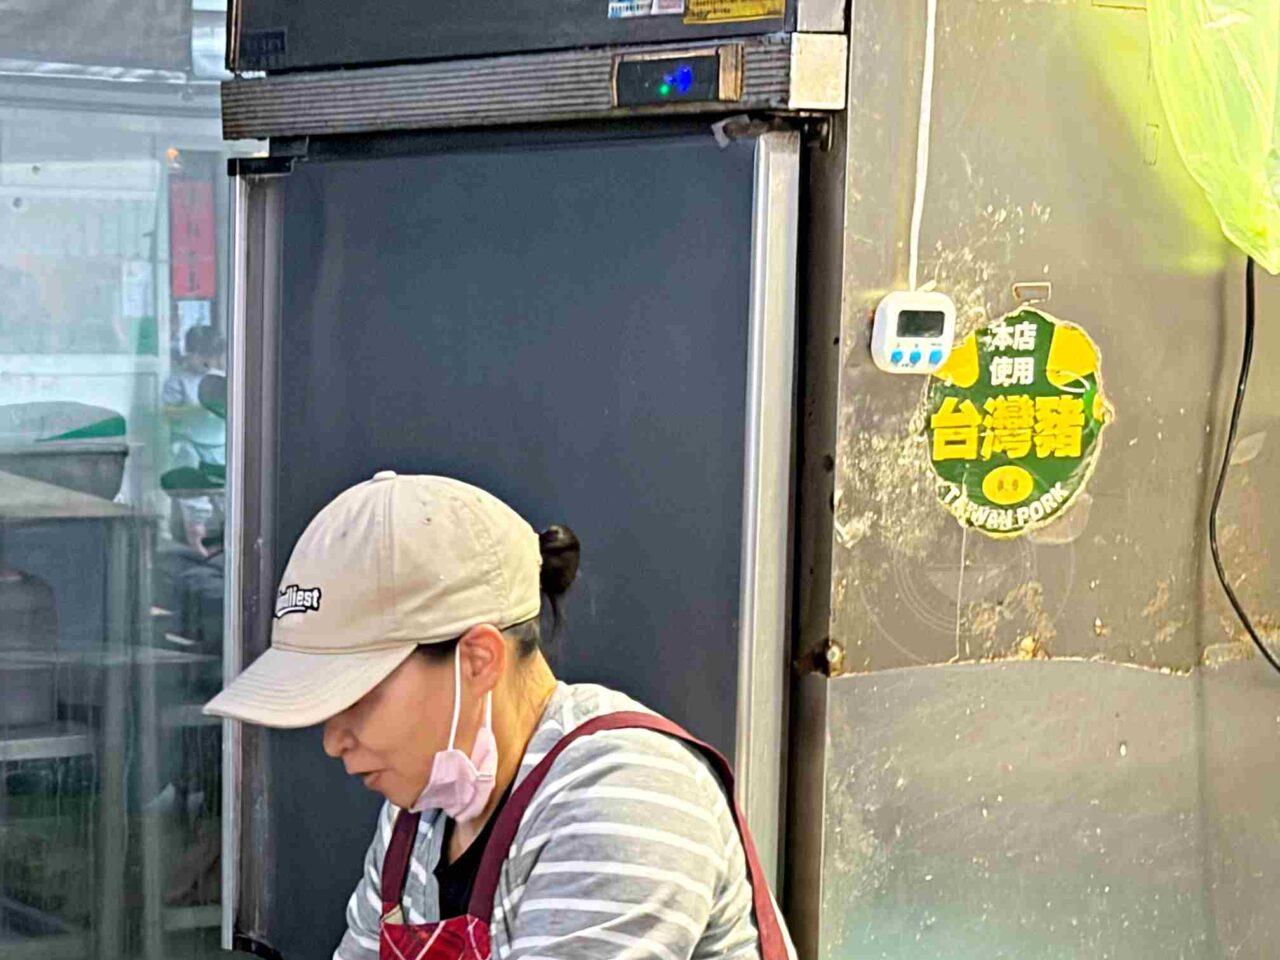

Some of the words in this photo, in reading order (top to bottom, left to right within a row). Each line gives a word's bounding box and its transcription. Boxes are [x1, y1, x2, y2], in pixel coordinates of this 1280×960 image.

[987, 322, 1037, 352] 本店
[989, 356, 1035, 387] 使用
[931, 395, 1085, 460] 台灣豬
[1016, 482, 1070, 526] PORK
